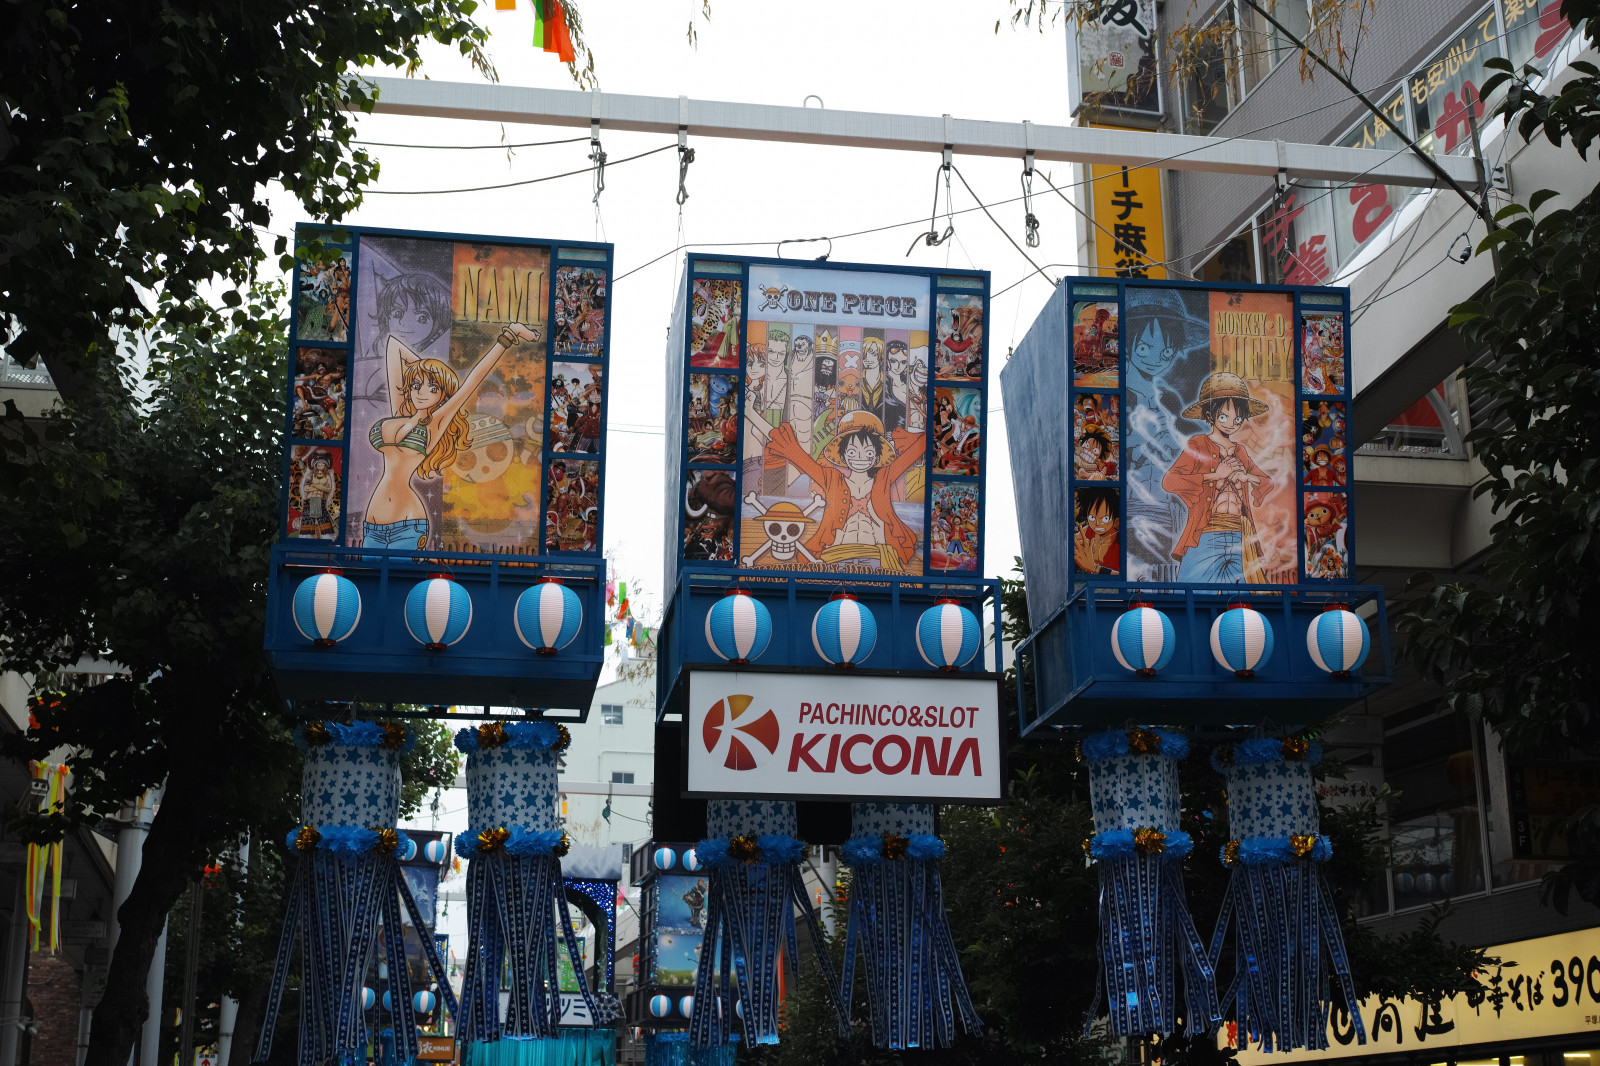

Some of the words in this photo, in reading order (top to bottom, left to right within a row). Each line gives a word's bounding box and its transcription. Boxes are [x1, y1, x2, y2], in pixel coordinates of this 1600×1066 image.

[459, 265, 545, 326] NAMI
[787, 289, 837, 313] ONE
[842, 293, 917, 318] PIECE
[1216, 336, 1293, 382] LUFFY
[799, 702, 979, 728] PACHINCO&SLOT
[787, 734, 982, 776] KICONA
[1551, 955, 1600, 1007] 390
